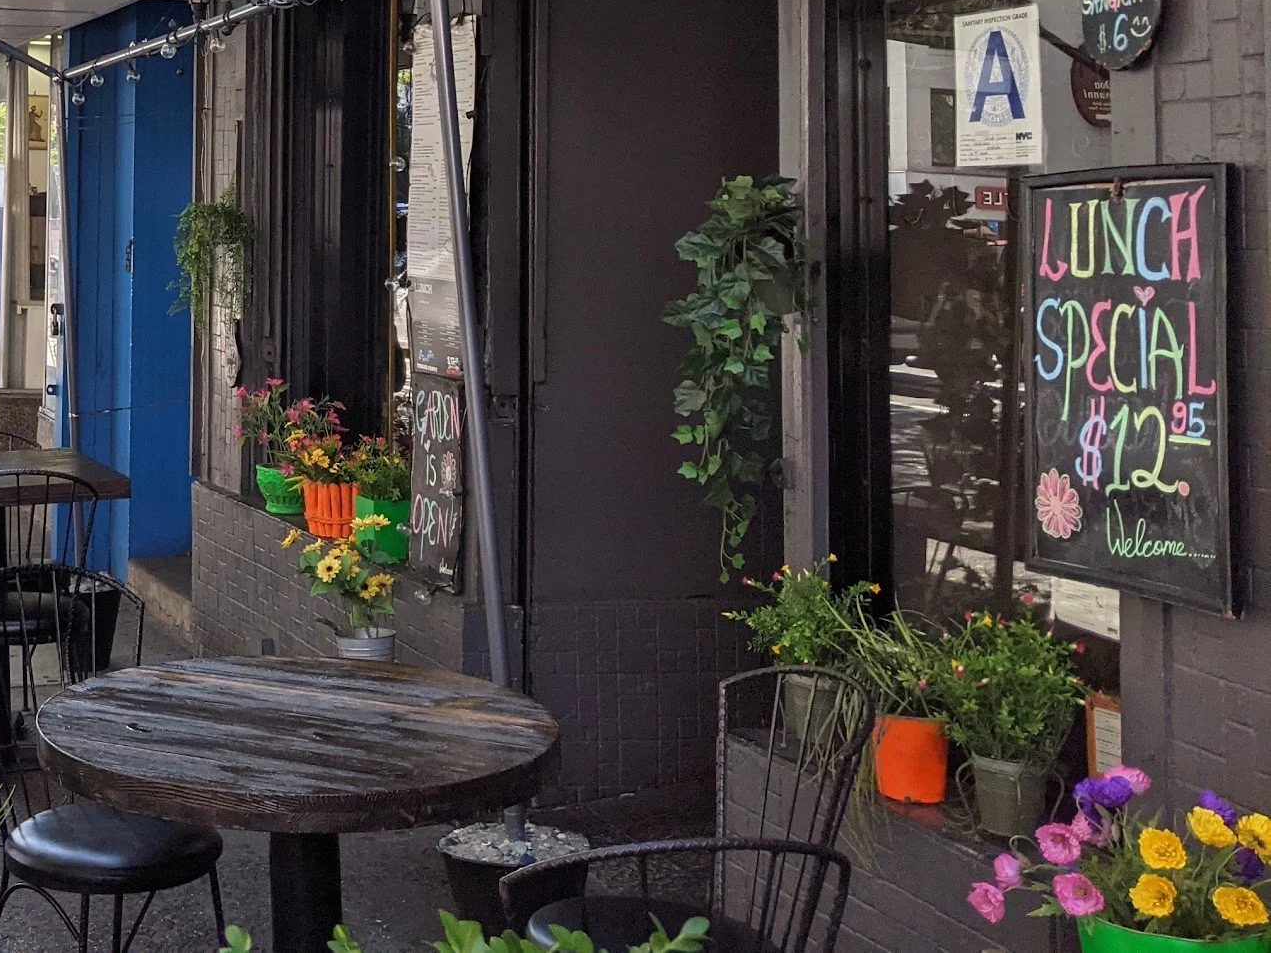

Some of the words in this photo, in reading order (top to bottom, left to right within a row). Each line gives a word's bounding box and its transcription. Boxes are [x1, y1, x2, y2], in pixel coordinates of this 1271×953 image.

[962, 18, 983, 28] SANITARY
[983, 15, 1011, 25] INSPECTION
[1011, 12, 1028, 20] GRADE
[968, 30, 1026, 123] A
[1015, 132, 1033, 141] NYC
[1039, 185, 1206, 281] LUNCH
[1034, 296, 1217, 422] SPECIAL
[415, 390, 460, 445] GARDEN
[426, 454, 437, 487] IS
[412, 493, 449, 562] OPEN
